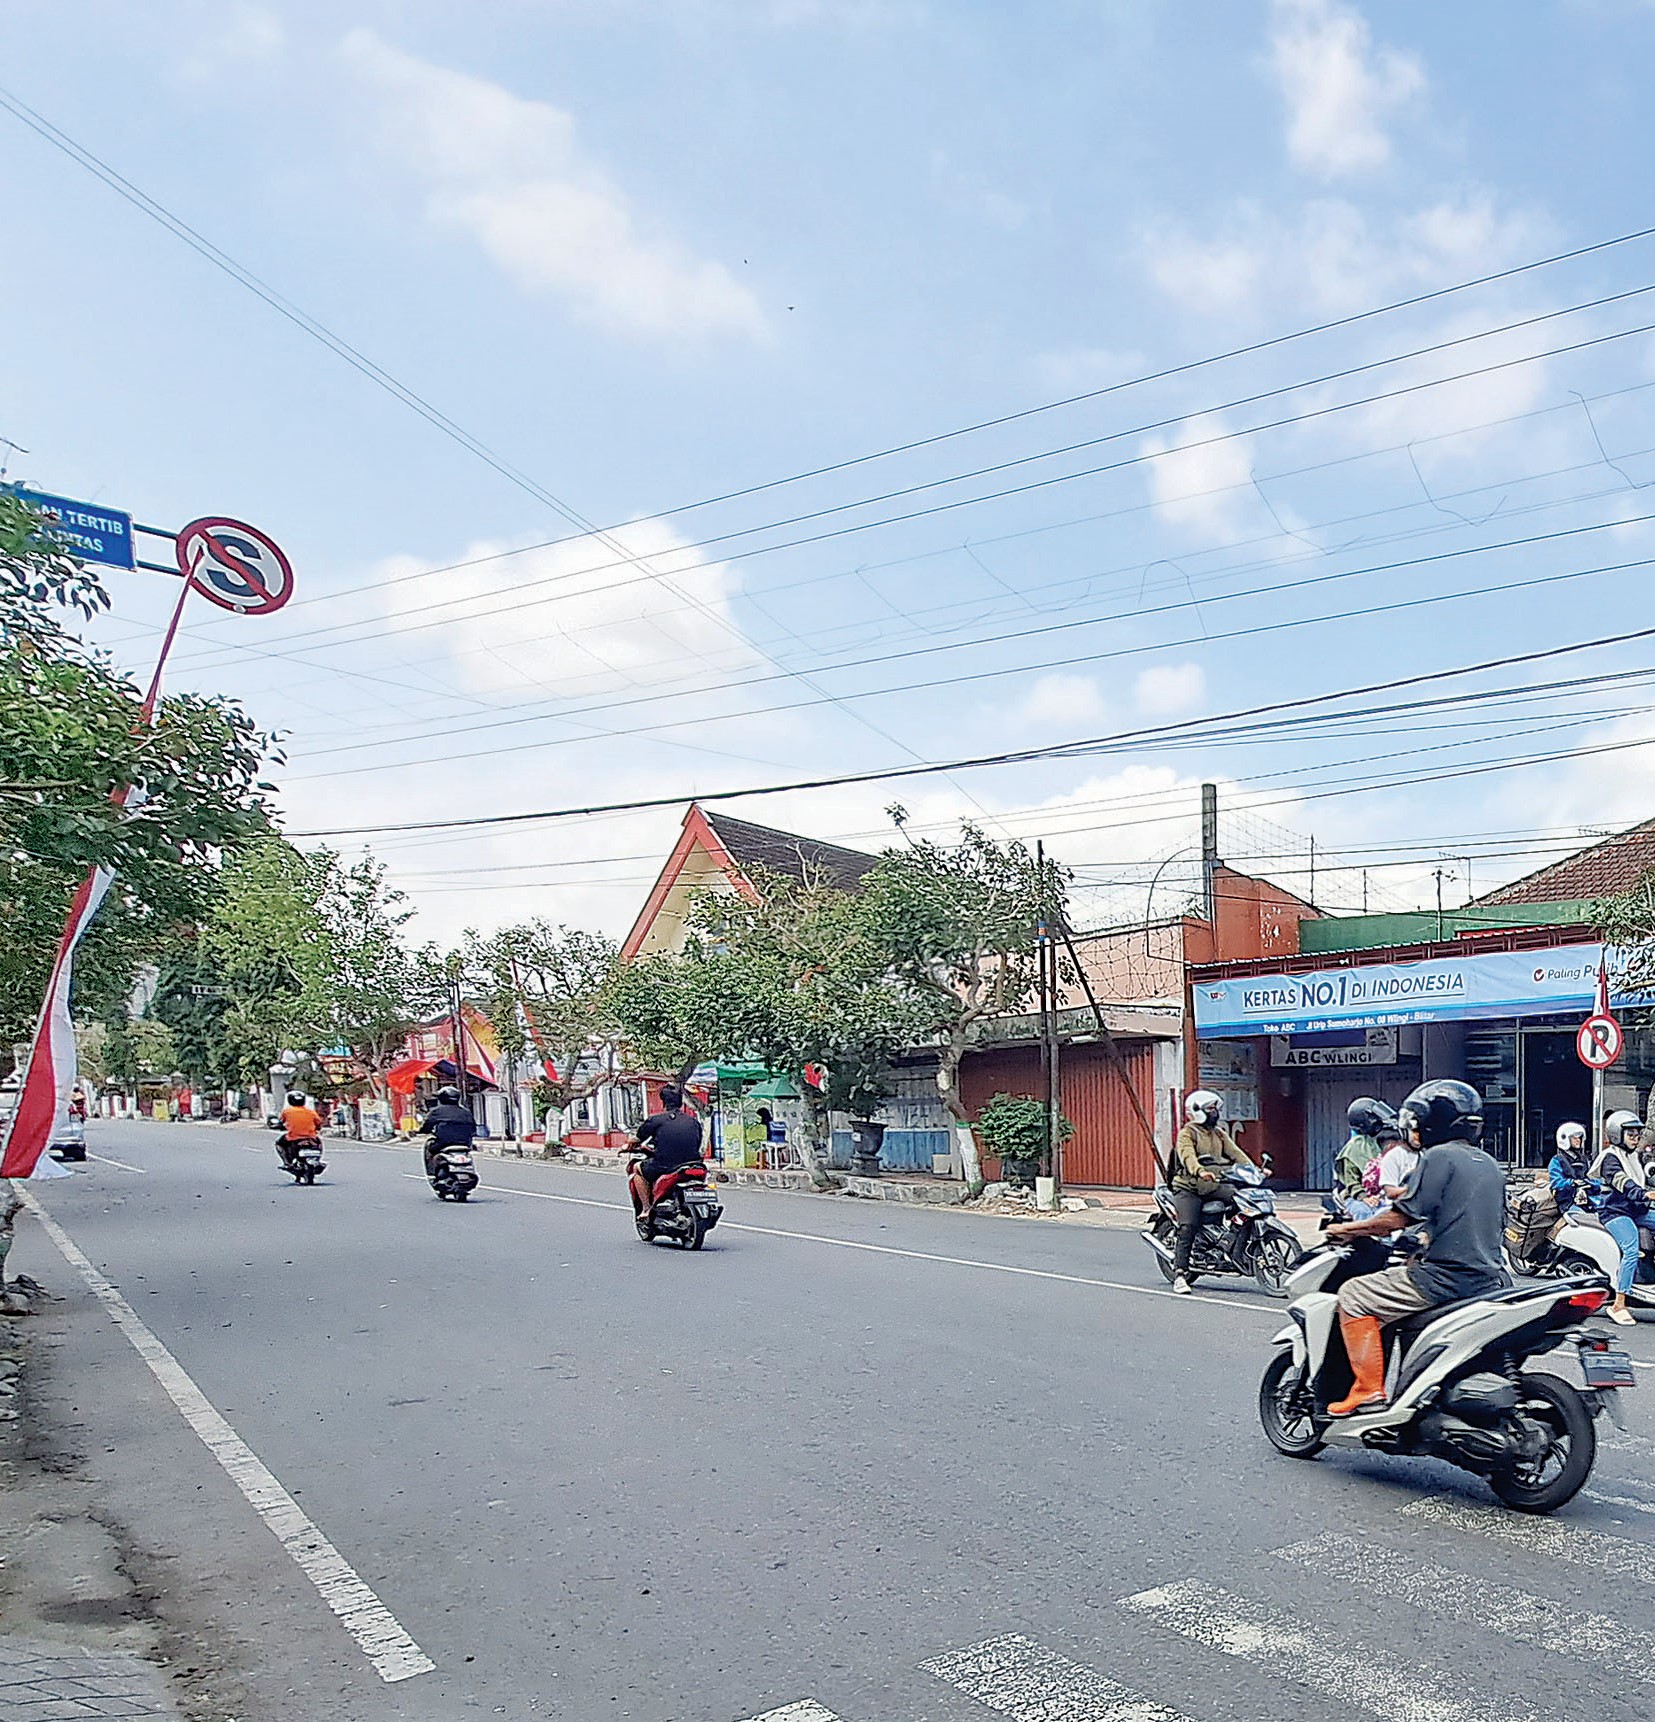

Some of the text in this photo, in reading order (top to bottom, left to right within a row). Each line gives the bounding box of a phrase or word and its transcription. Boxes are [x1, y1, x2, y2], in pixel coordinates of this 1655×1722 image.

[66, 509, 123, 535] TERTIB
[1547, 963, 1618, 980] Paling Puih
[1243, 973, 1464, 1008] KERTAS NO.1 DI INDONESIA
[1263, 1023, 1296, 1033] Toko ABC
[1285, 1050, 1372, 1065] ABC WLINGI
